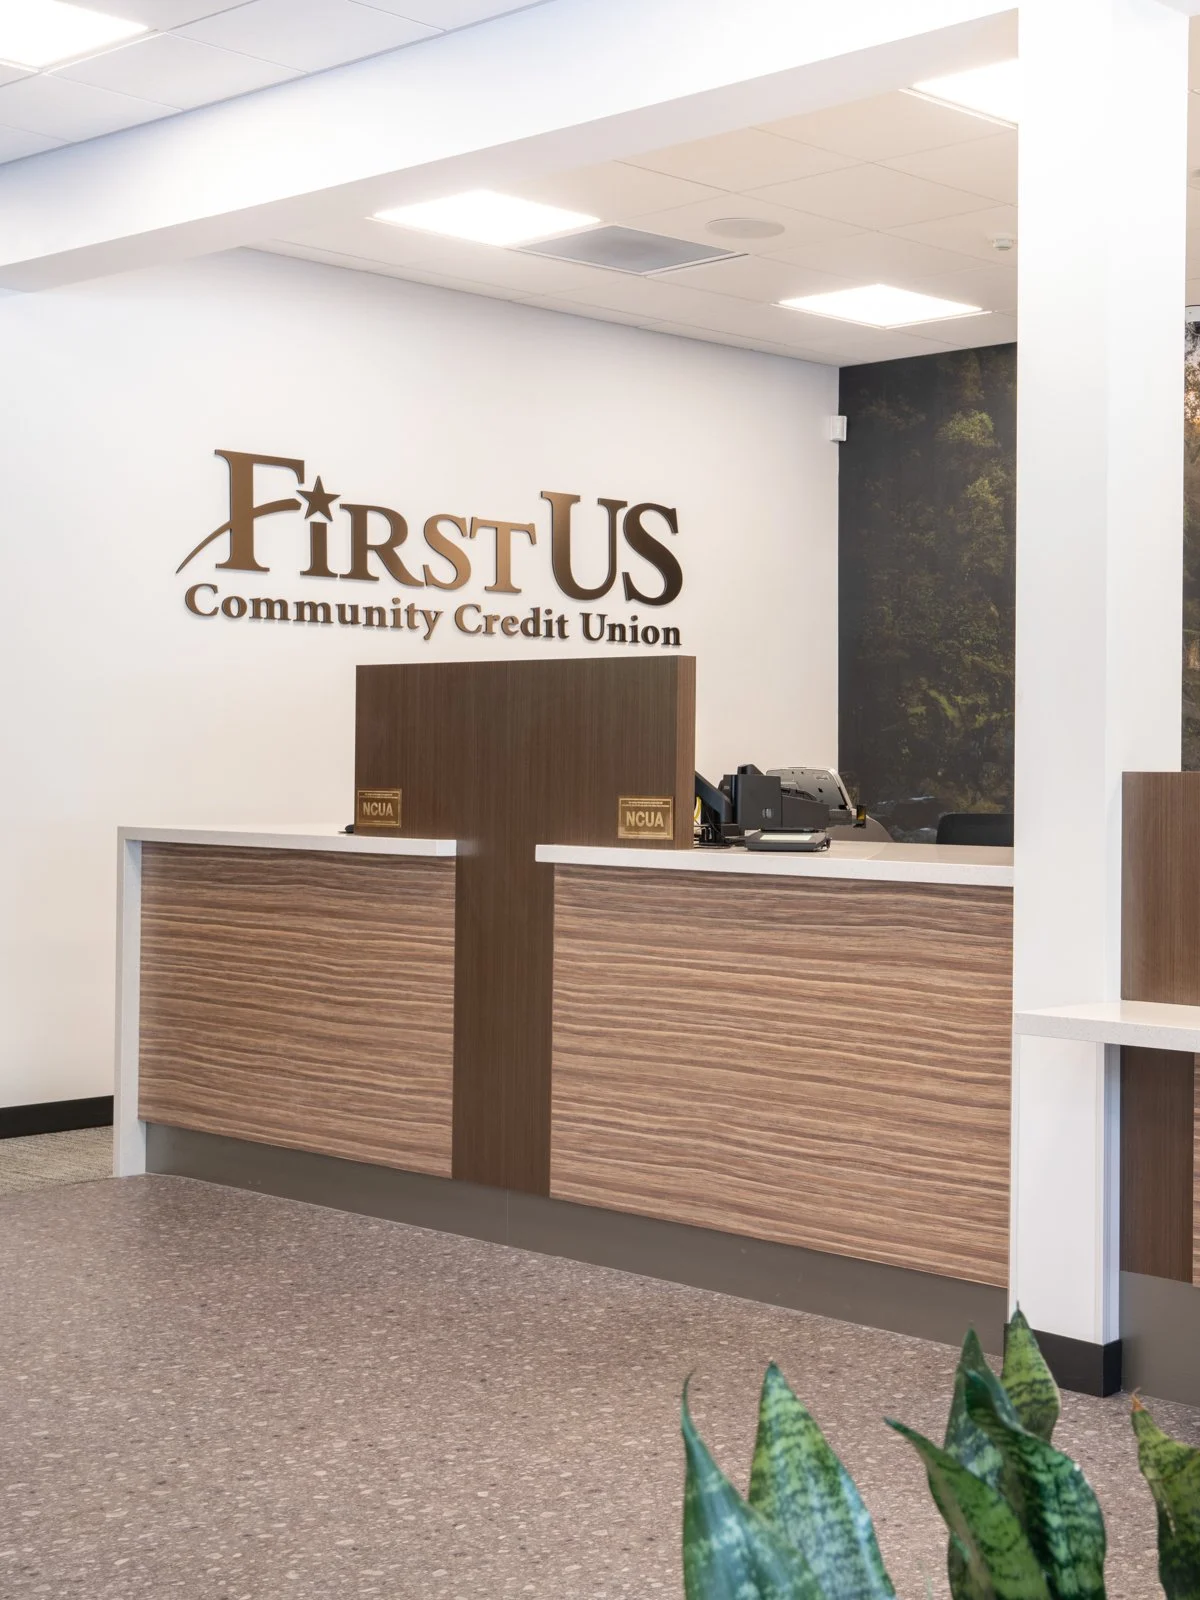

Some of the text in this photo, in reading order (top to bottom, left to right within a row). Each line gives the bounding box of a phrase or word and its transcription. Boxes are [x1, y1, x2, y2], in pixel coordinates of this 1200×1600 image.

[541, 490, 684, 606] US
[184, 583, 682, 646] Community Credit Union
[362, 802, 394, 817] NCUA
[626, 811, 664, 827] NCUA
